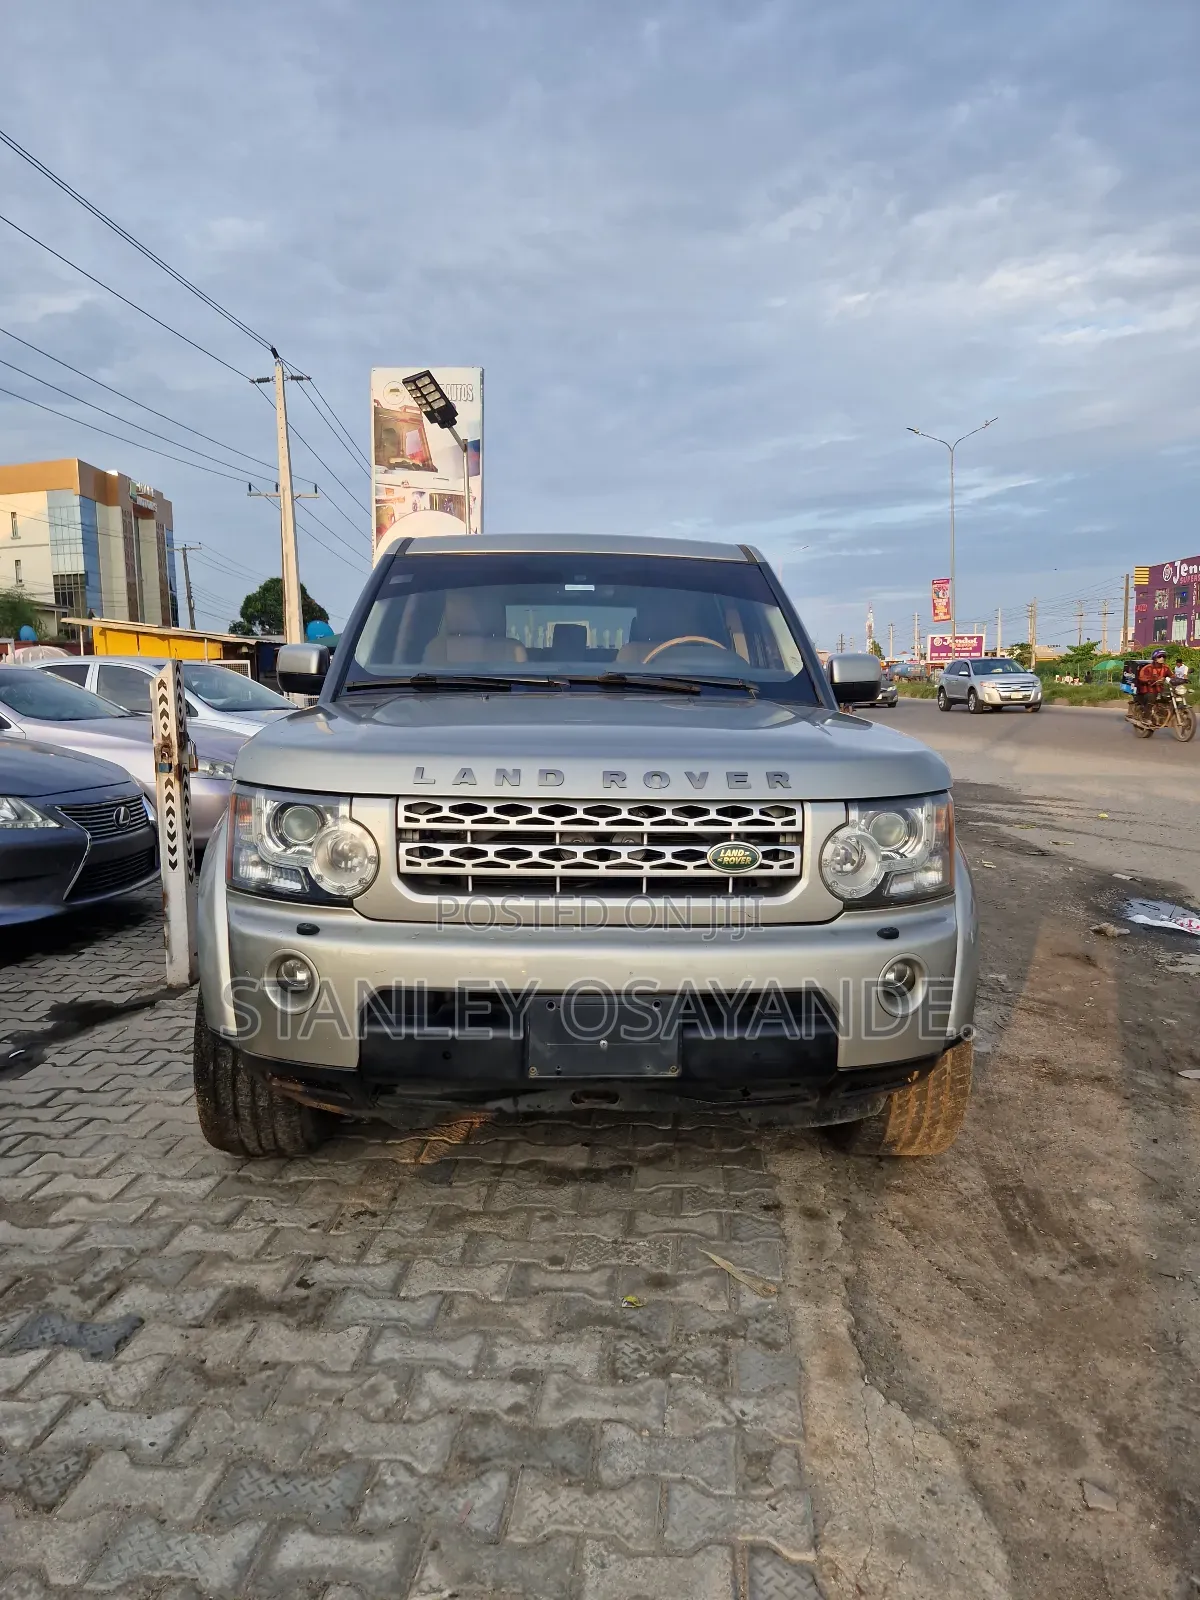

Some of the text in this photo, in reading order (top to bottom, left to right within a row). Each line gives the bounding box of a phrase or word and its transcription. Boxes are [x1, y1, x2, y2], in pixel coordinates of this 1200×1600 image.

[446, 383, 473, 402] AUTOS
[1172, 560, 1200, 584] Jen
[412, 766, 792, 789] LAND ROVER
[720, 849, 745, 857] LAND
[722, 857, 752, 865] ROVER
